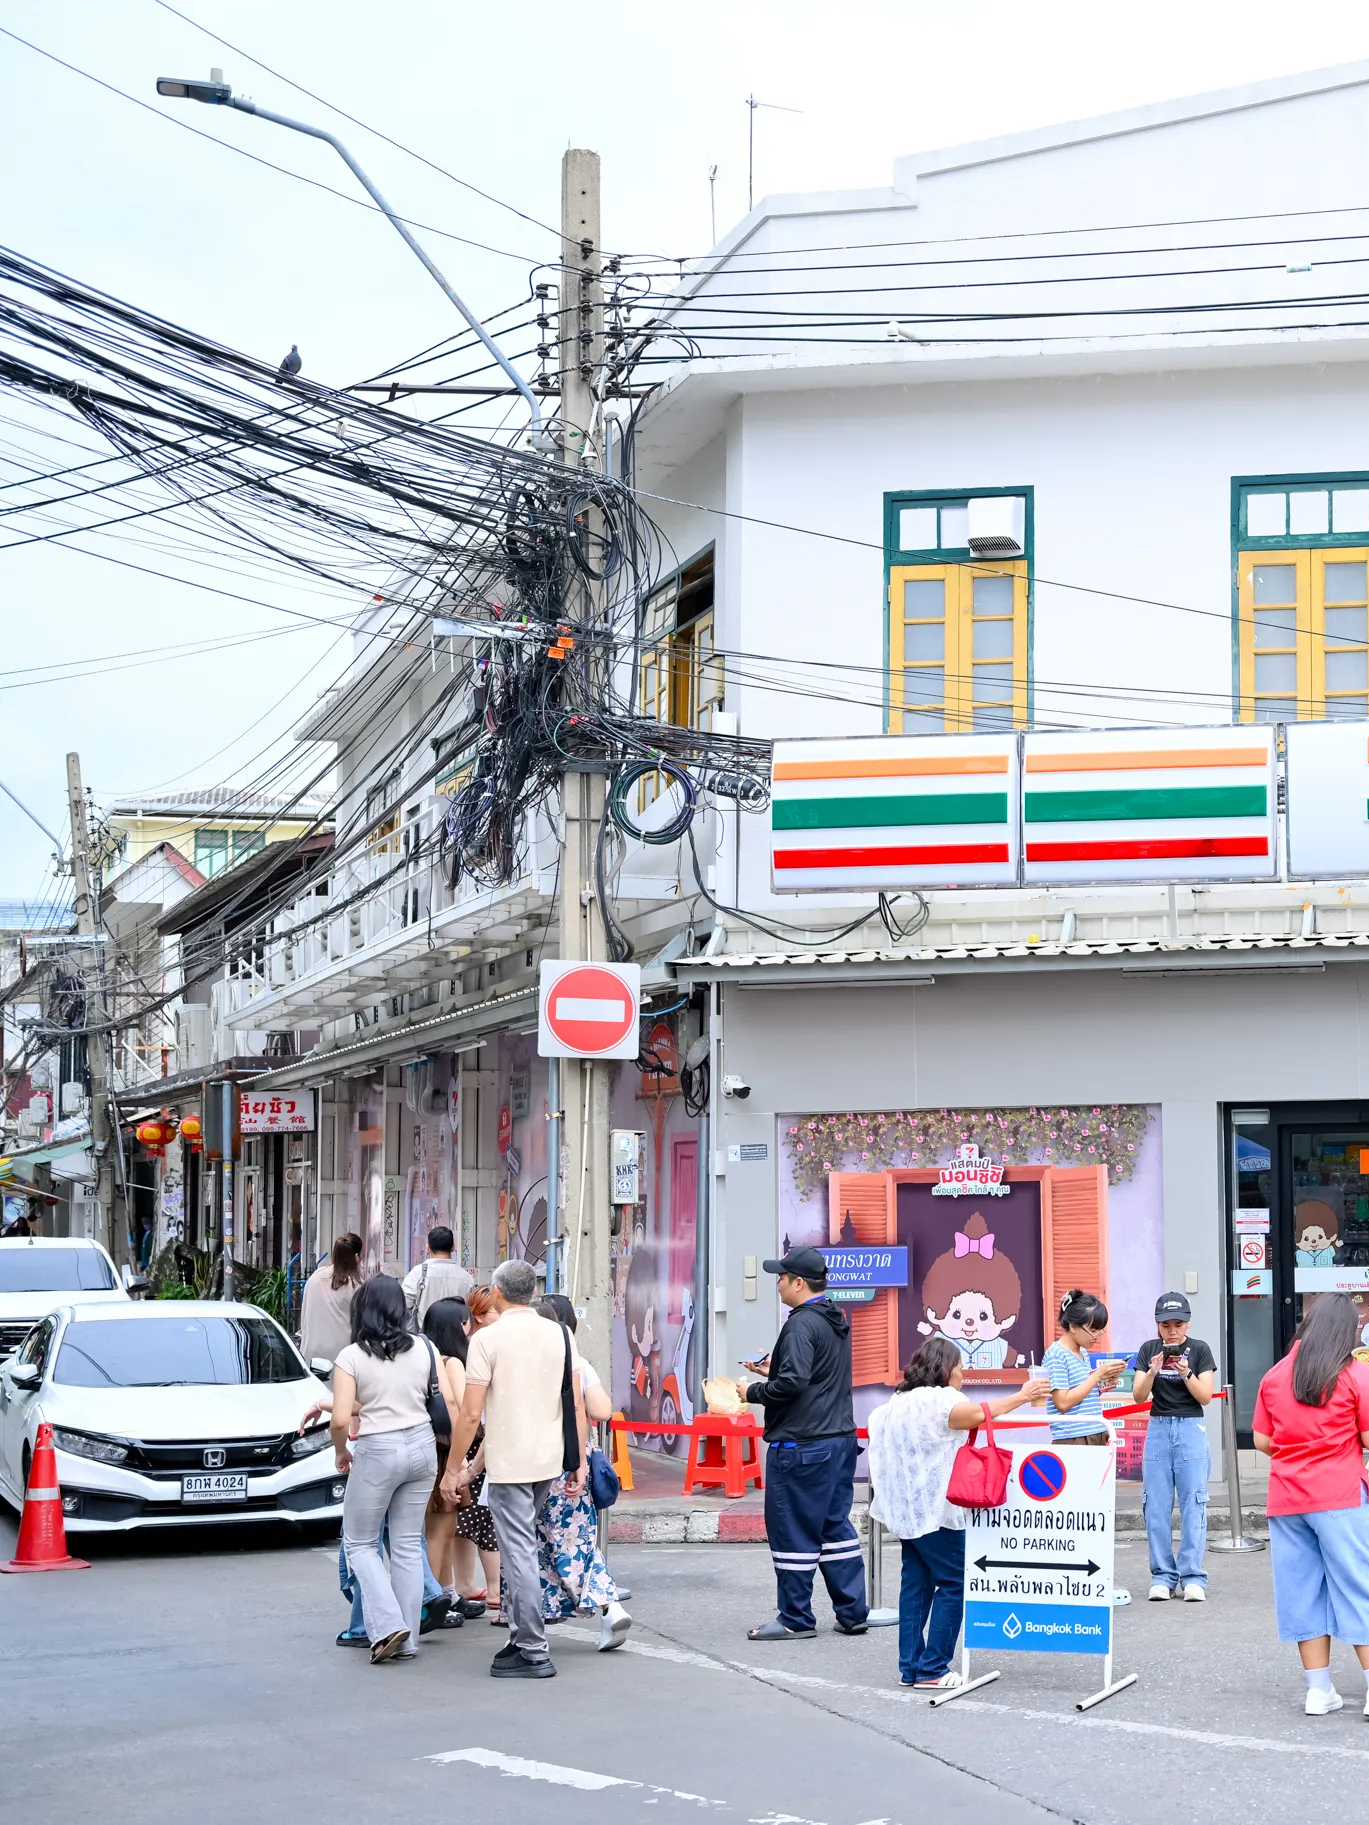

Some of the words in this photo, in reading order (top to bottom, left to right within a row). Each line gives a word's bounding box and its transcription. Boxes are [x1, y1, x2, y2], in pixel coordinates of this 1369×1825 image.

[214, 1476, 244, 1489] 4024
[971, 1508, 1106, 1532] หามจอดตลอดแนว
[1000, 1537, 1018, 1550] NO
[1023, 1538, 1076, 1552] PARKING
[1096, 1583, 1106, 1598] 2
[1025, 1621, 1073, 1636] Bangkok
[1074, 1623, 1103, 1636] Bank
